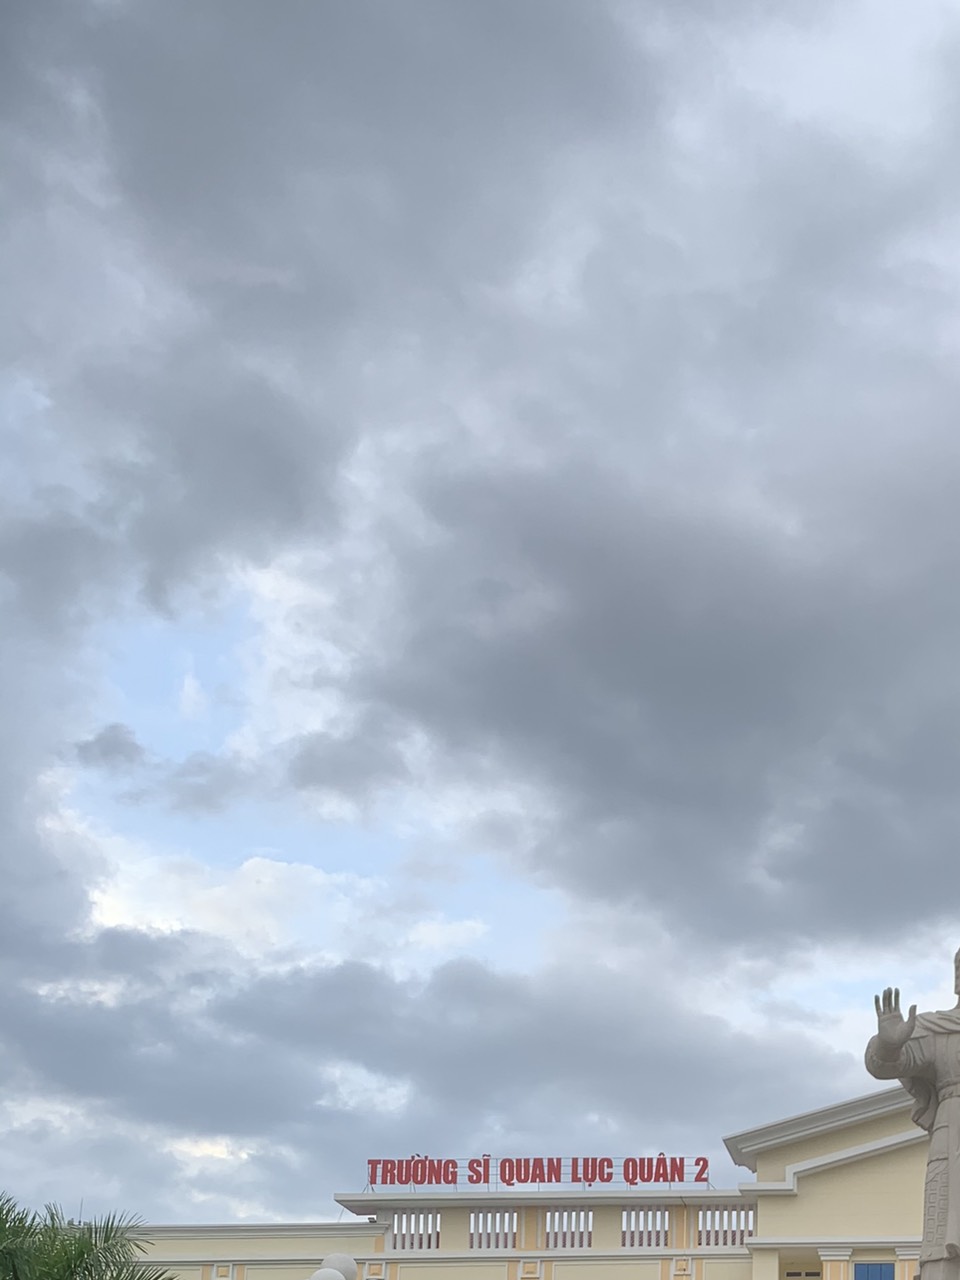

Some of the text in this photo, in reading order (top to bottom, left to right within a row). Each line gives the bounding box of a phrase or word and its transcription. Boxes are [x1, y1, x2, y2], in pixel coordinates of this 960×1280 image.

[367, 1152, 709, 1187] TRƯỜNG SĨ QUAN LỤC QUÂN 2
